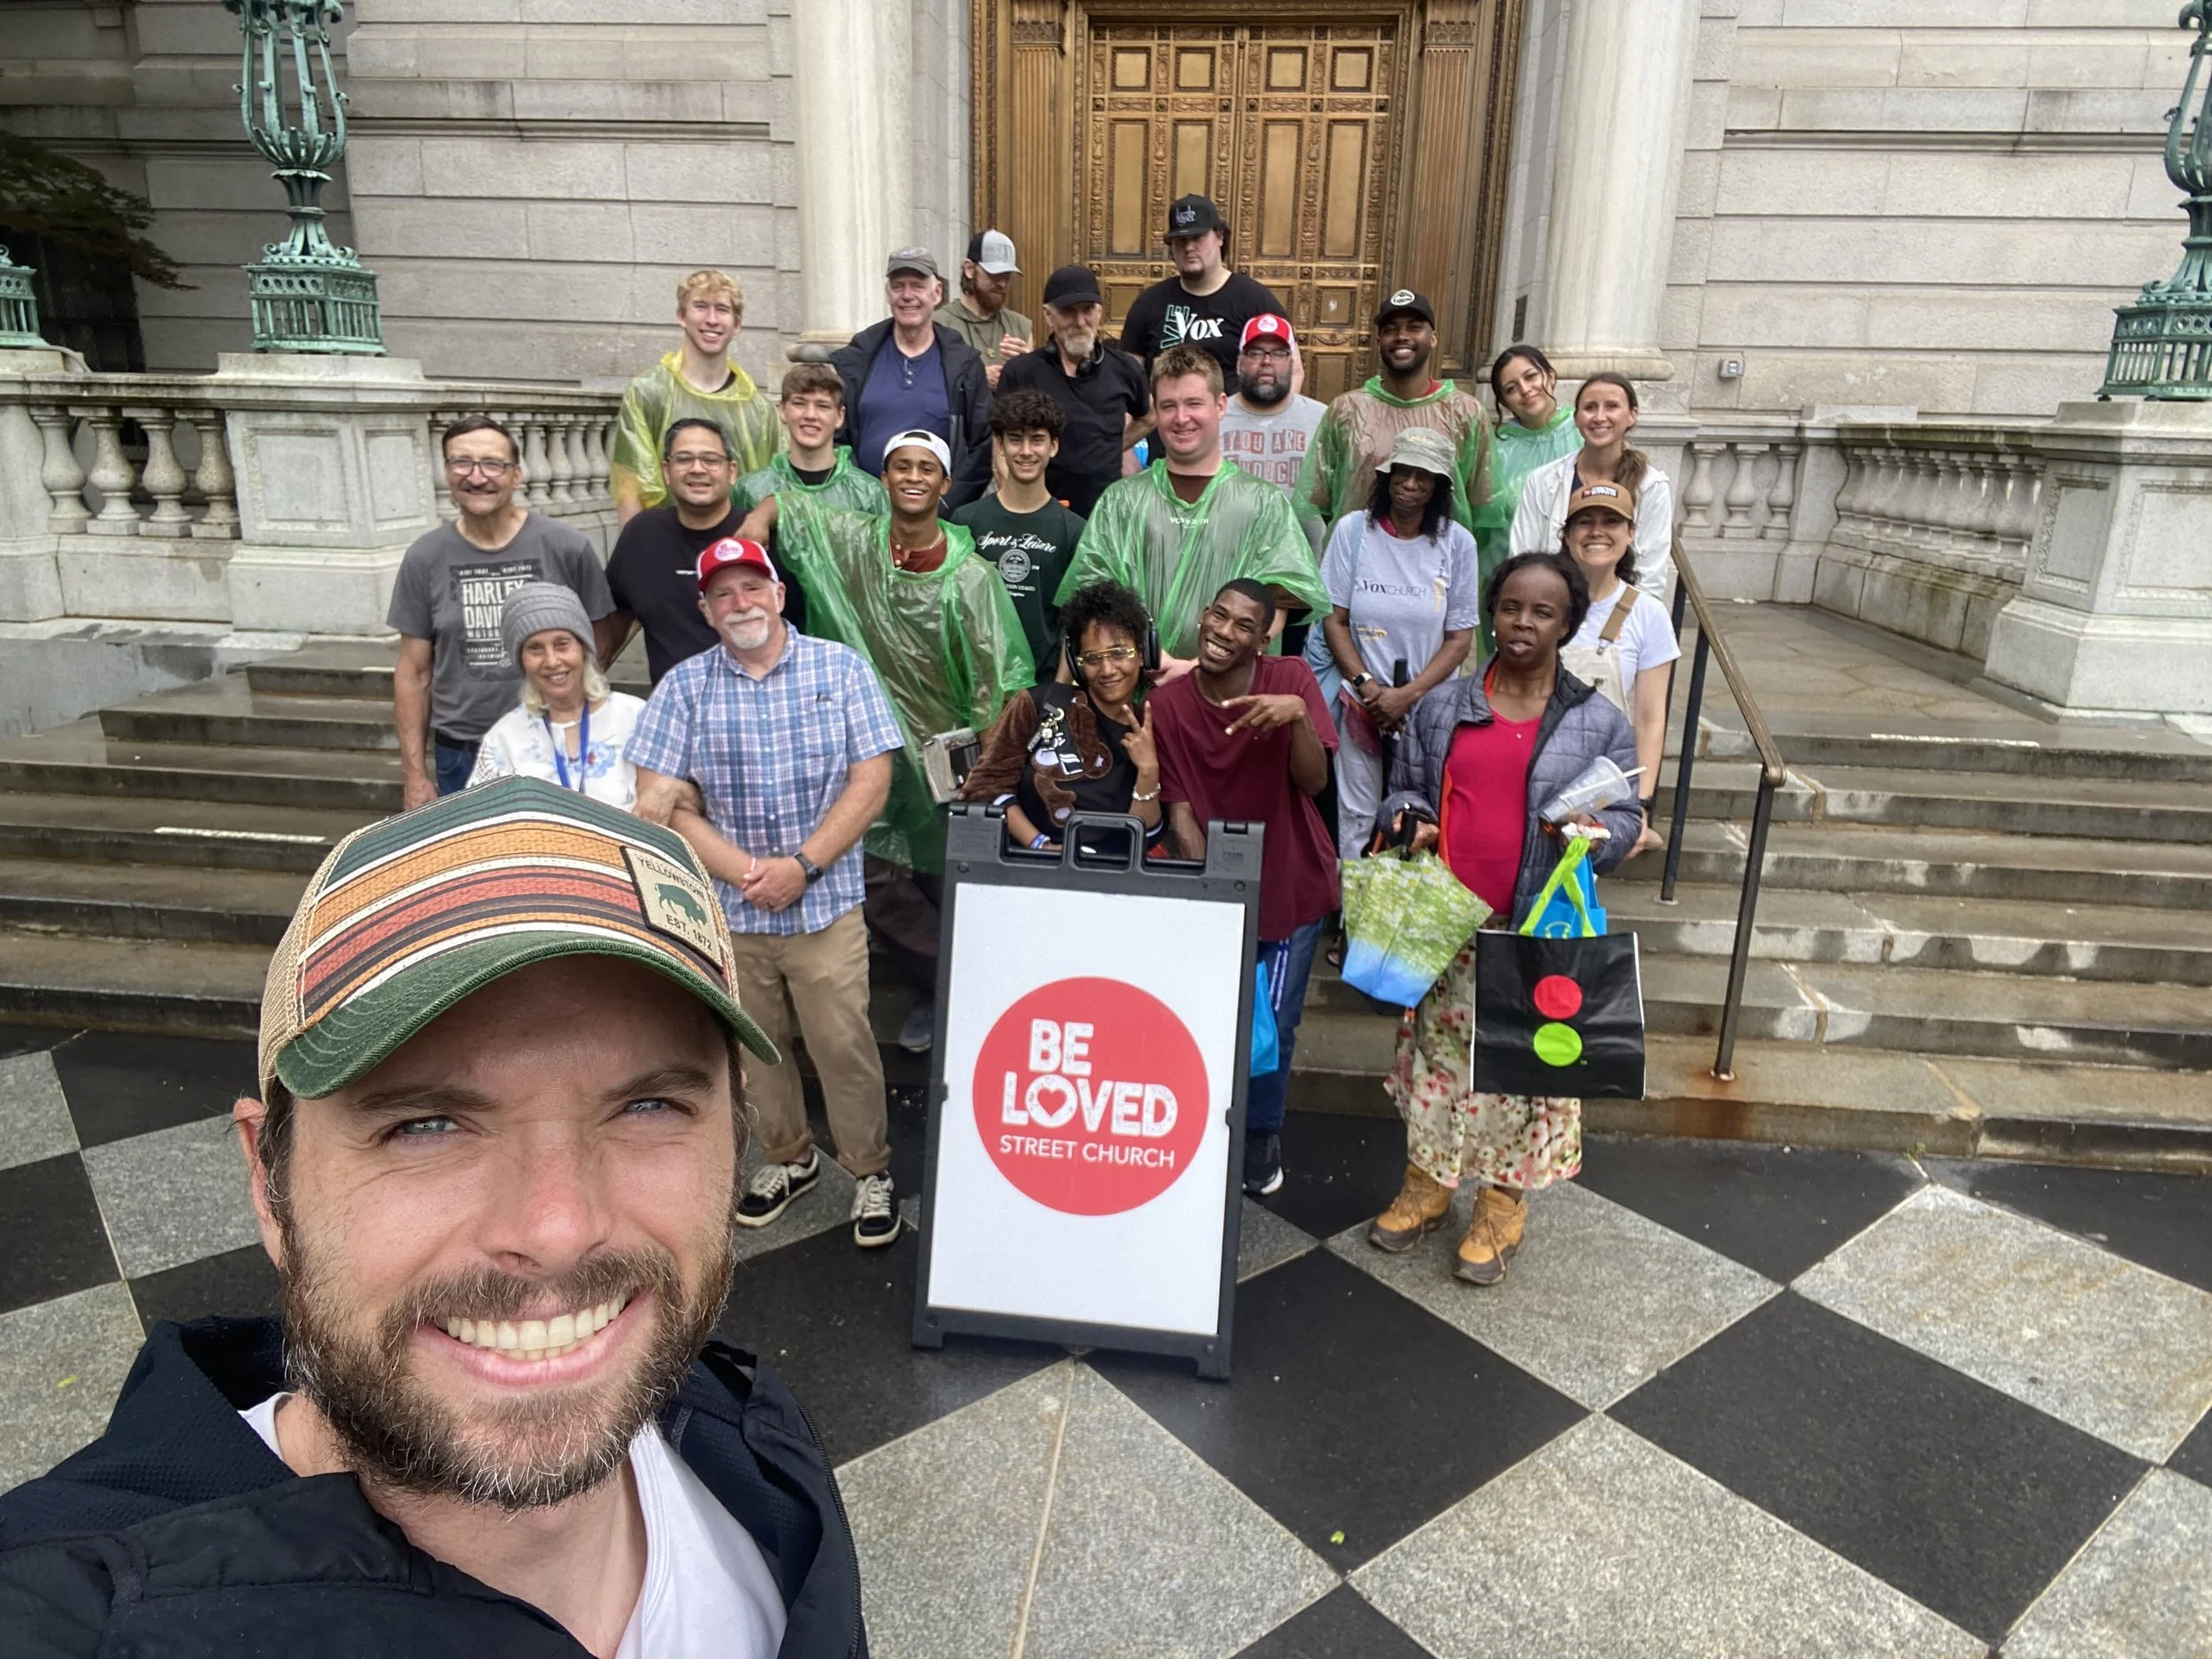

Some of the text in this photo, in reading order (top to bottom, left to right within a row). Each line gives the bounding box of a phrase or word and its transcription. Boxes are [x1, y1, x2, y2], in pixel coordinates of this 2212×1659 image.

[1226, 429, 1305, 453] YOU ARE
[1225, 455, 1303, 488] NOUGH
[978, 531, 1012, 549] Sport
[1018, 534, 1056, 553] Leisure
[637, 856, 706, 901] YELLOWSTONE
[666, 913, 712, 951] EST. 1872
[1029, 1018, 1094, 1076] BE
[1002, 1071, 1179, 1138] LOVED
[1000, 1134, 1175, 1169] STREET CHURCH
